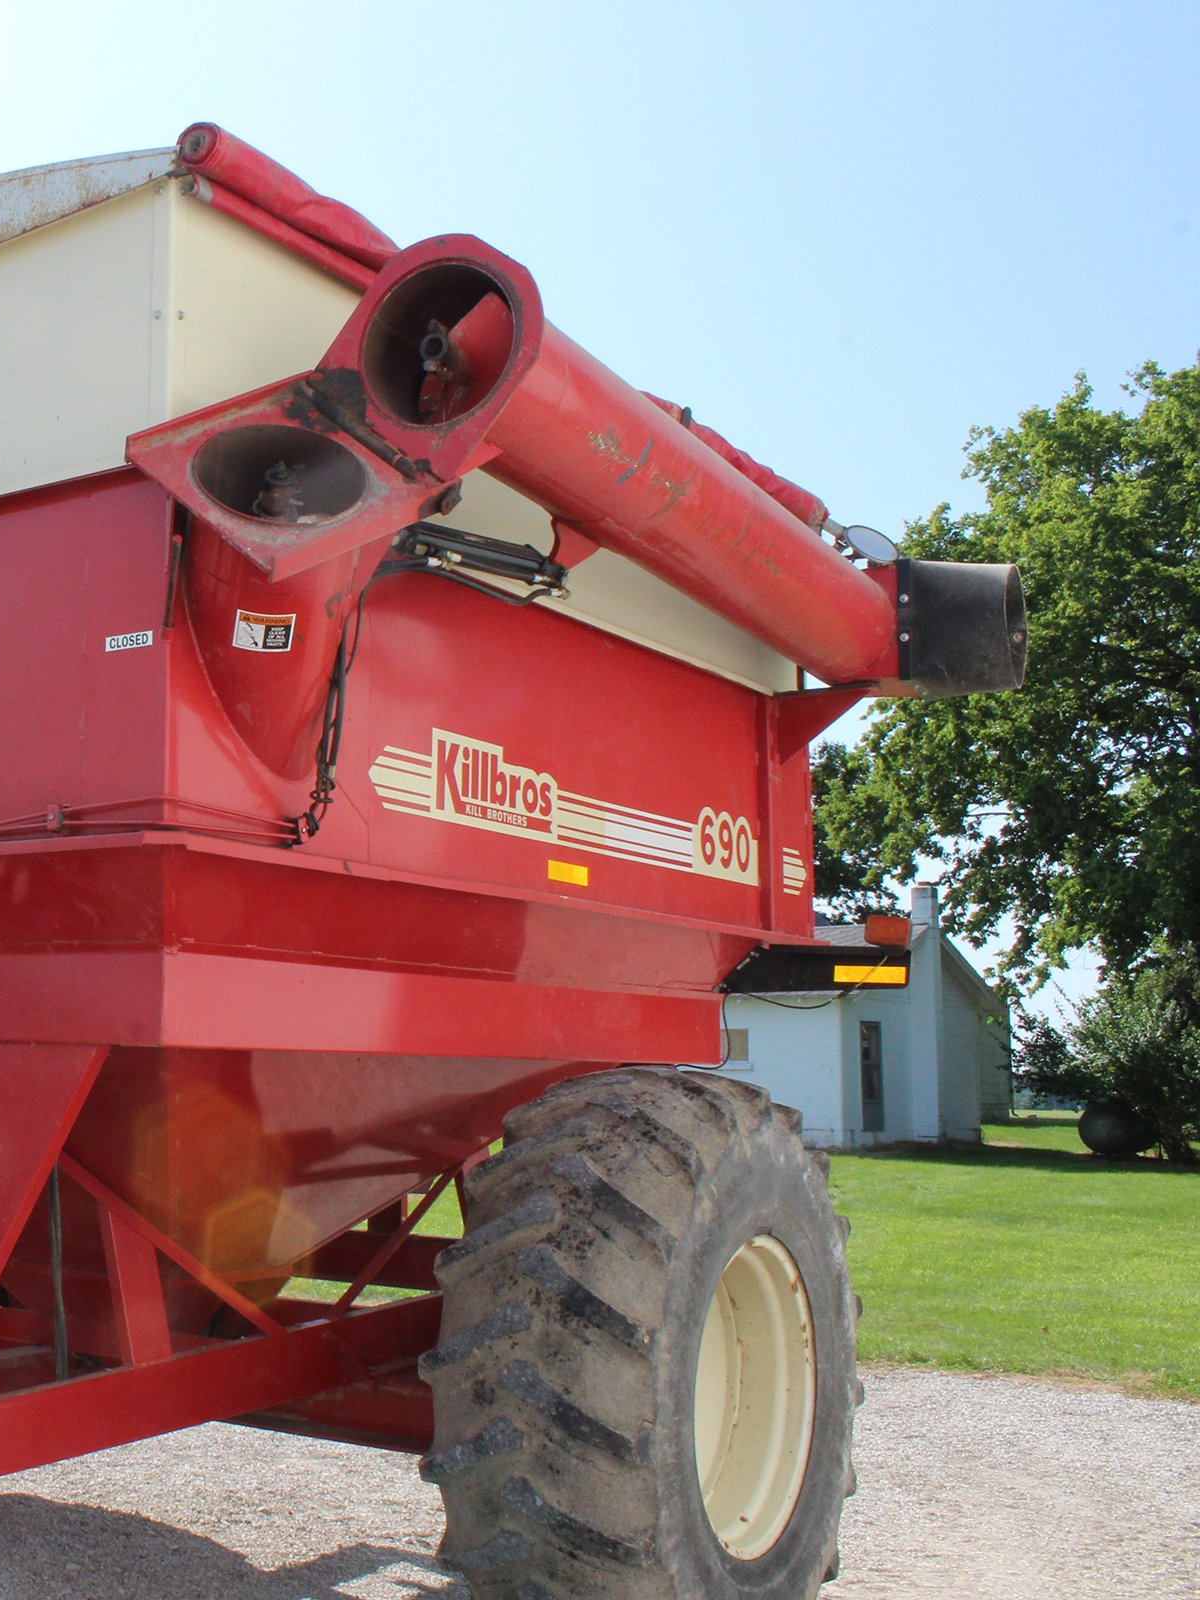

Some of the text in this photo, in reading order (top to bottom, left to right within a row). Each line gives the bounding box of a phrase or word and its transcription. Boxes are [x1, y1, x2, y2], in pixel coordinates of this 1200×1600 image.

[253, 617, 291, 625] WARNING
[109, 633, 149, 649] CLOSED
[436, 739, 552, 817] Killbros
[465, 803, 528, 827] KILL BROTHERS
[700, 814, 750, 873] 690
